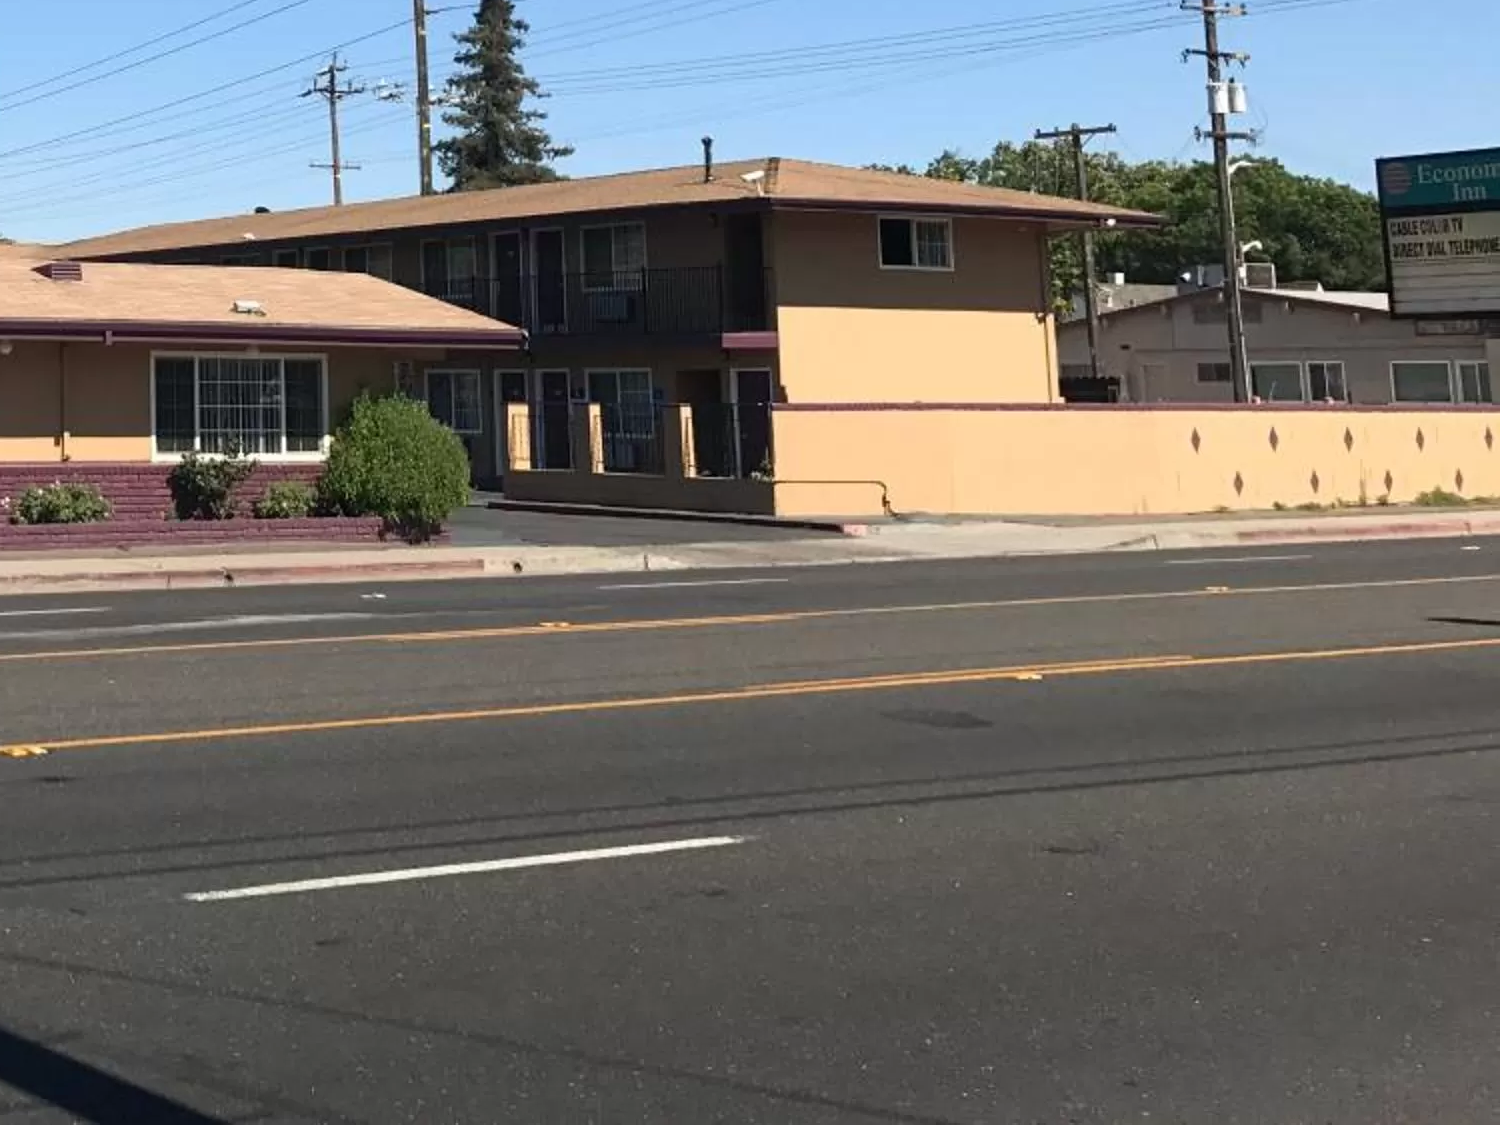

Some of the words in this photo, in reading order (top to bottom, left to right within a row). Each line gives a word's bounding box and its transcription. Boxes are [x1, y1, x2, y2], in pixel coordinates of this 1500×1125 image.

[1453, 183, 1487, 202] Inn
[1391, 219, 1419, 236] CABLE
[1451, 217, 1463, 233] TV
[1393, 242, 1424, 258] DIRECT
